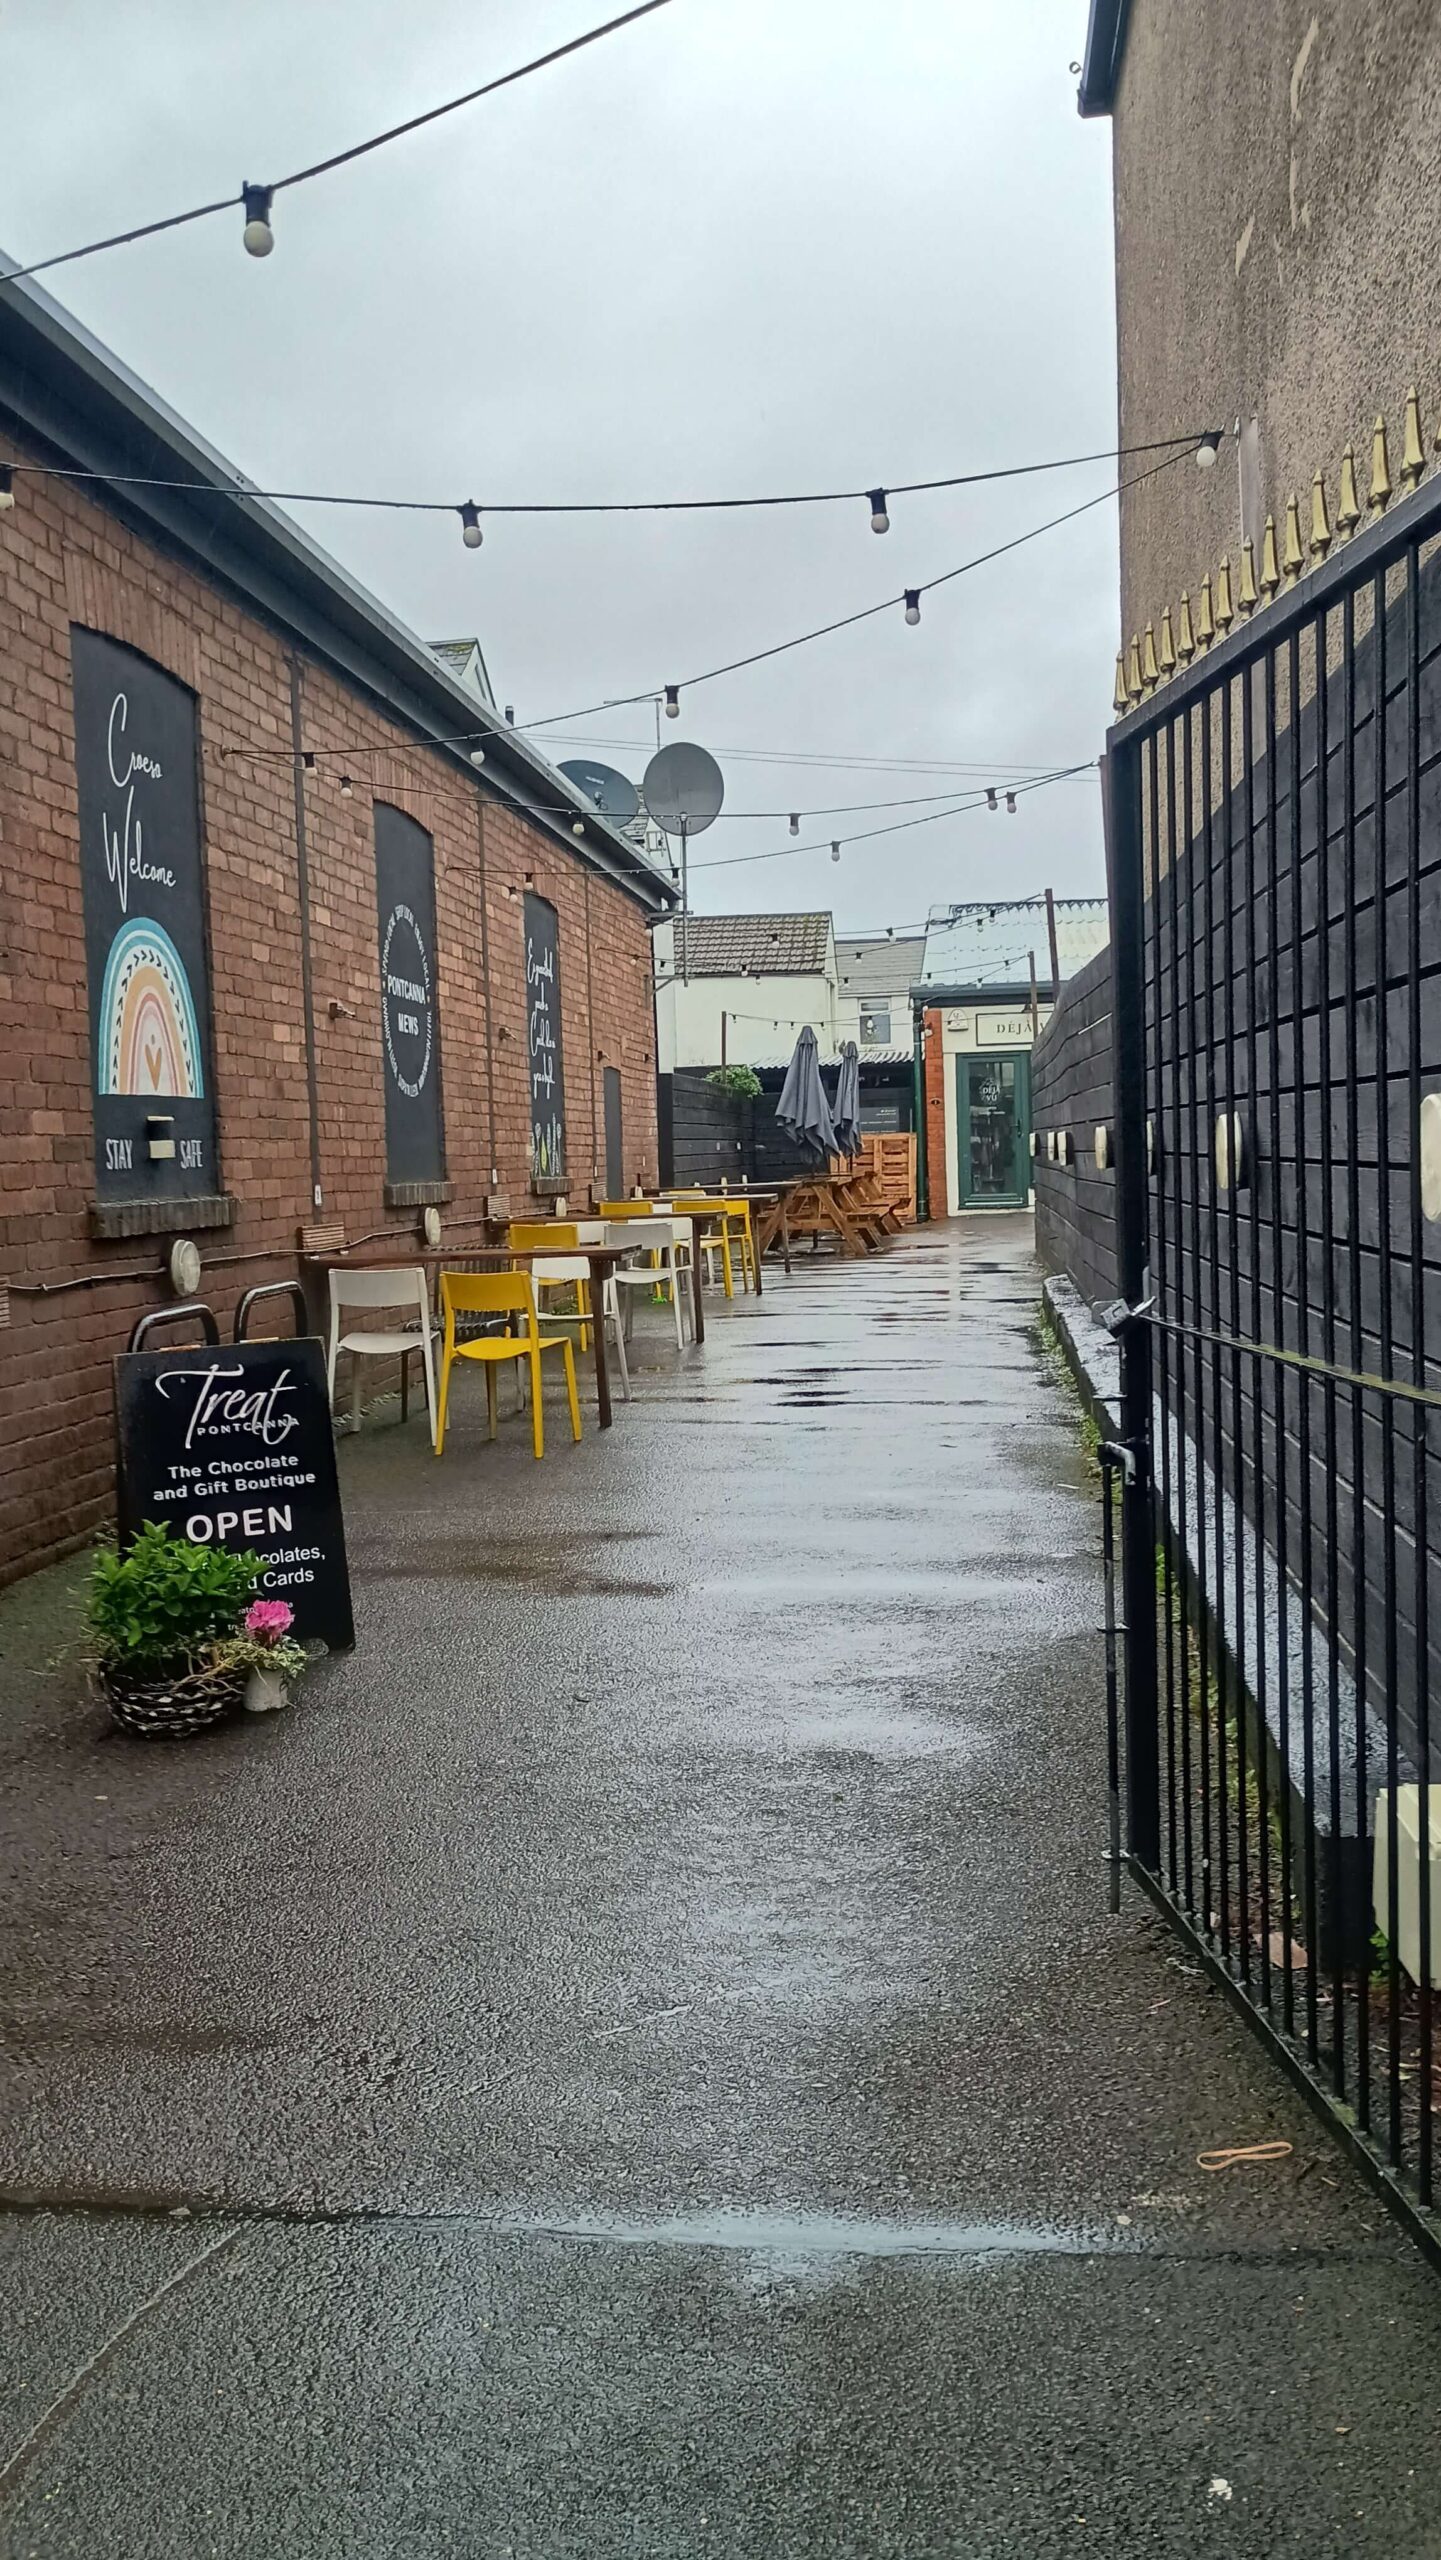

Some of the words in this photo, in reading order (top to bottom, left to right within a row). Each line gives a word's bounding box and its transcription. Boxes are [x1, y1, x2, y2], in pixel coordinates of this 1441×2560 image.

[107, 692, 163, 787] Croeso
[103, 785, 176, 913] Welcome
[387, 974, 426, 1005] PONTCANNA
[106, 1138, 132, 1170] STAY
[180, 1140, 203, 1169] SAFE
[155, 1364, 298, 1449] Treat
[197, 1417, 300, 1436] PONTCANNA
[168, 1466, 202, 1479] The
[208, 1455, 299, 1475] Chocolate
[153, 1485, 188, 1500] and
[194, 1481, 229, 1496] Gift
[235, 1473, 316, 1491] Boutique
[186, 1504, 292, 1543] OPEN
[263, 1567, 315, 1587] Cards
